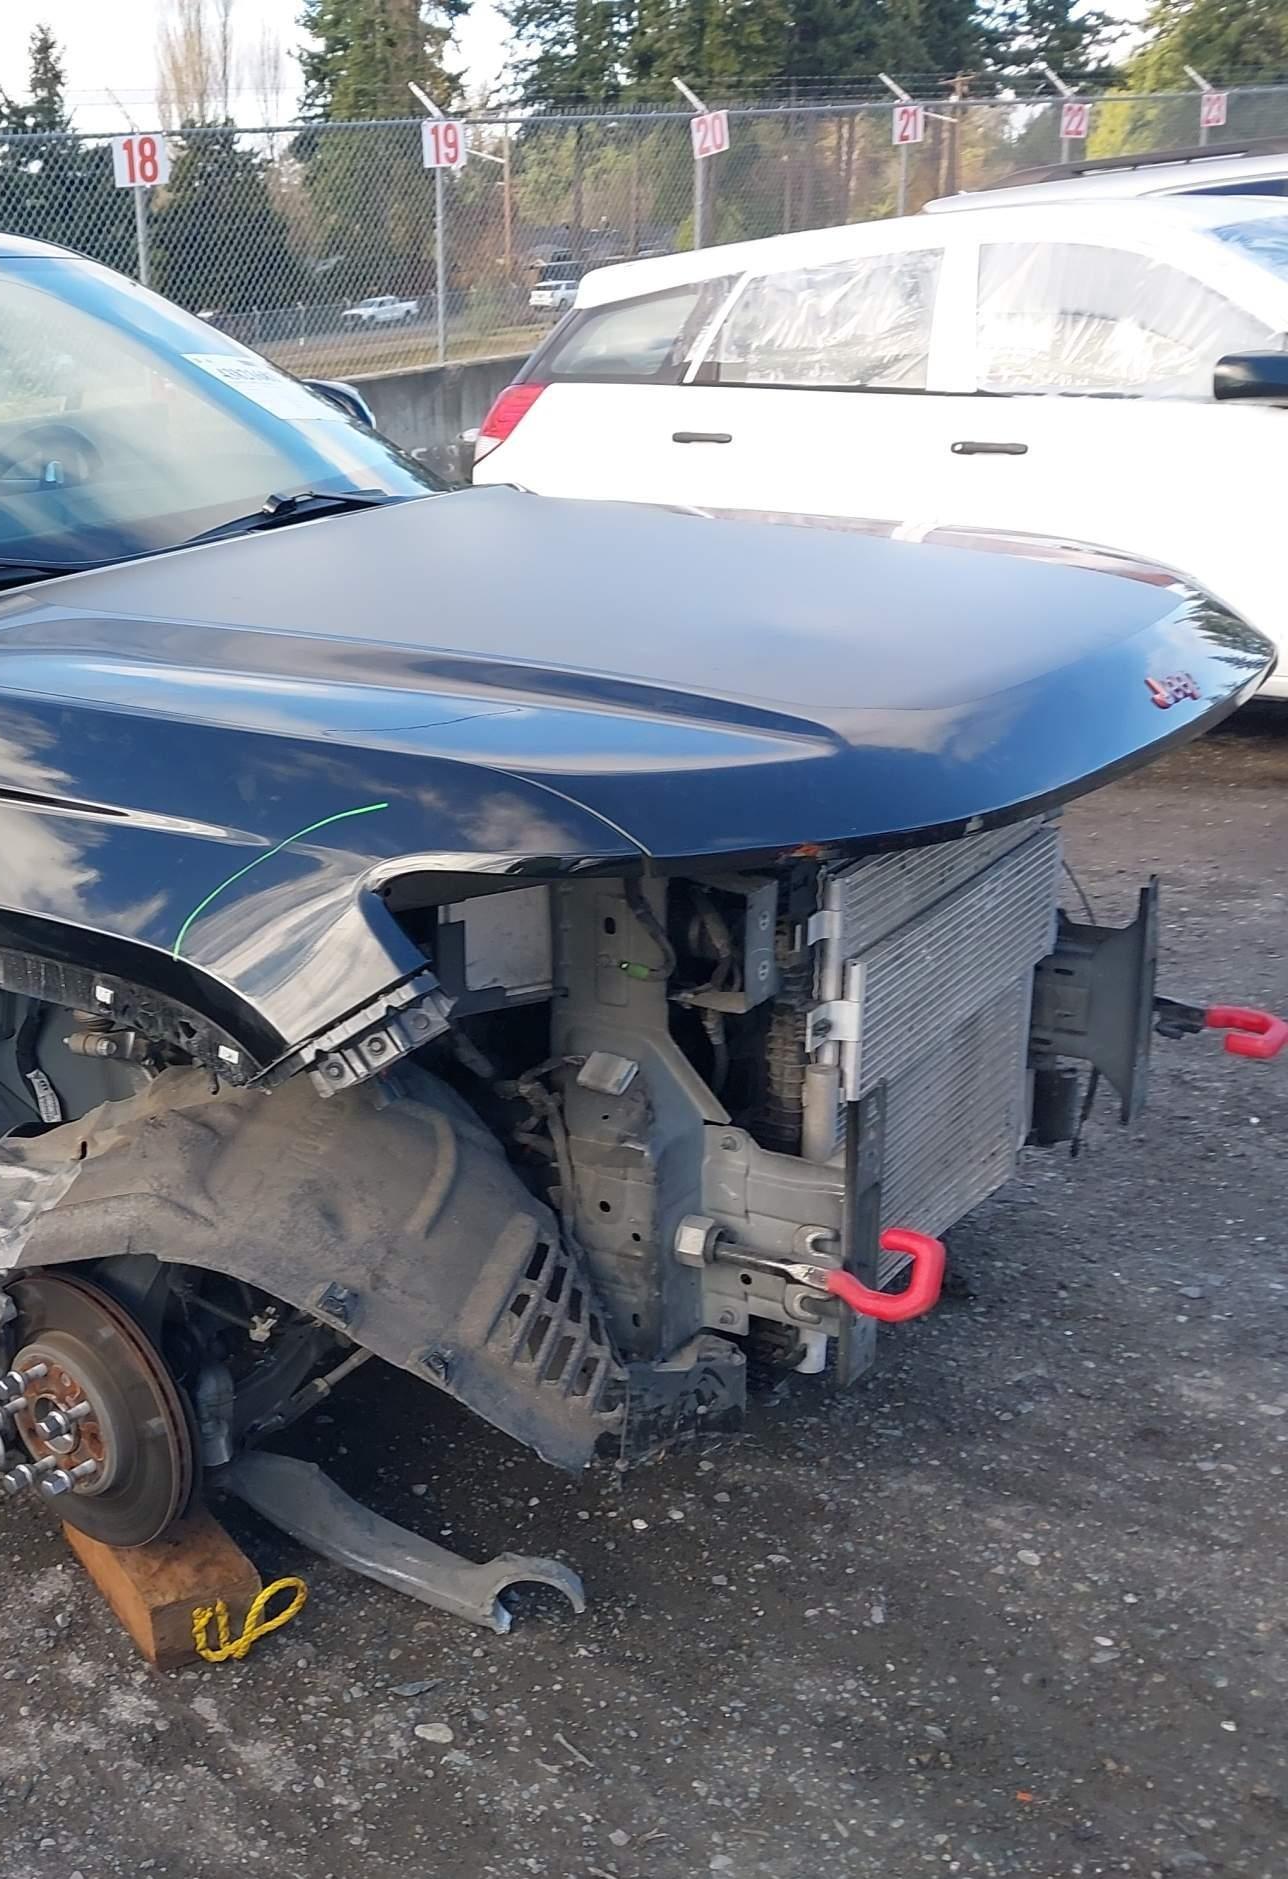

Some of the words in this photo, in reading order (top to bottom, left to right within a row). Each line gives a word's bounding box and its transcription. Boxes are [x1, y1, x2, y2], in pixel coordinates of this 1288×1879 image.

[431, 125, 459, 163] 19
[696, 113, 724, 155] 20
[899, 108, 918, 142] 21
[123, 138, 158, 182] 18
